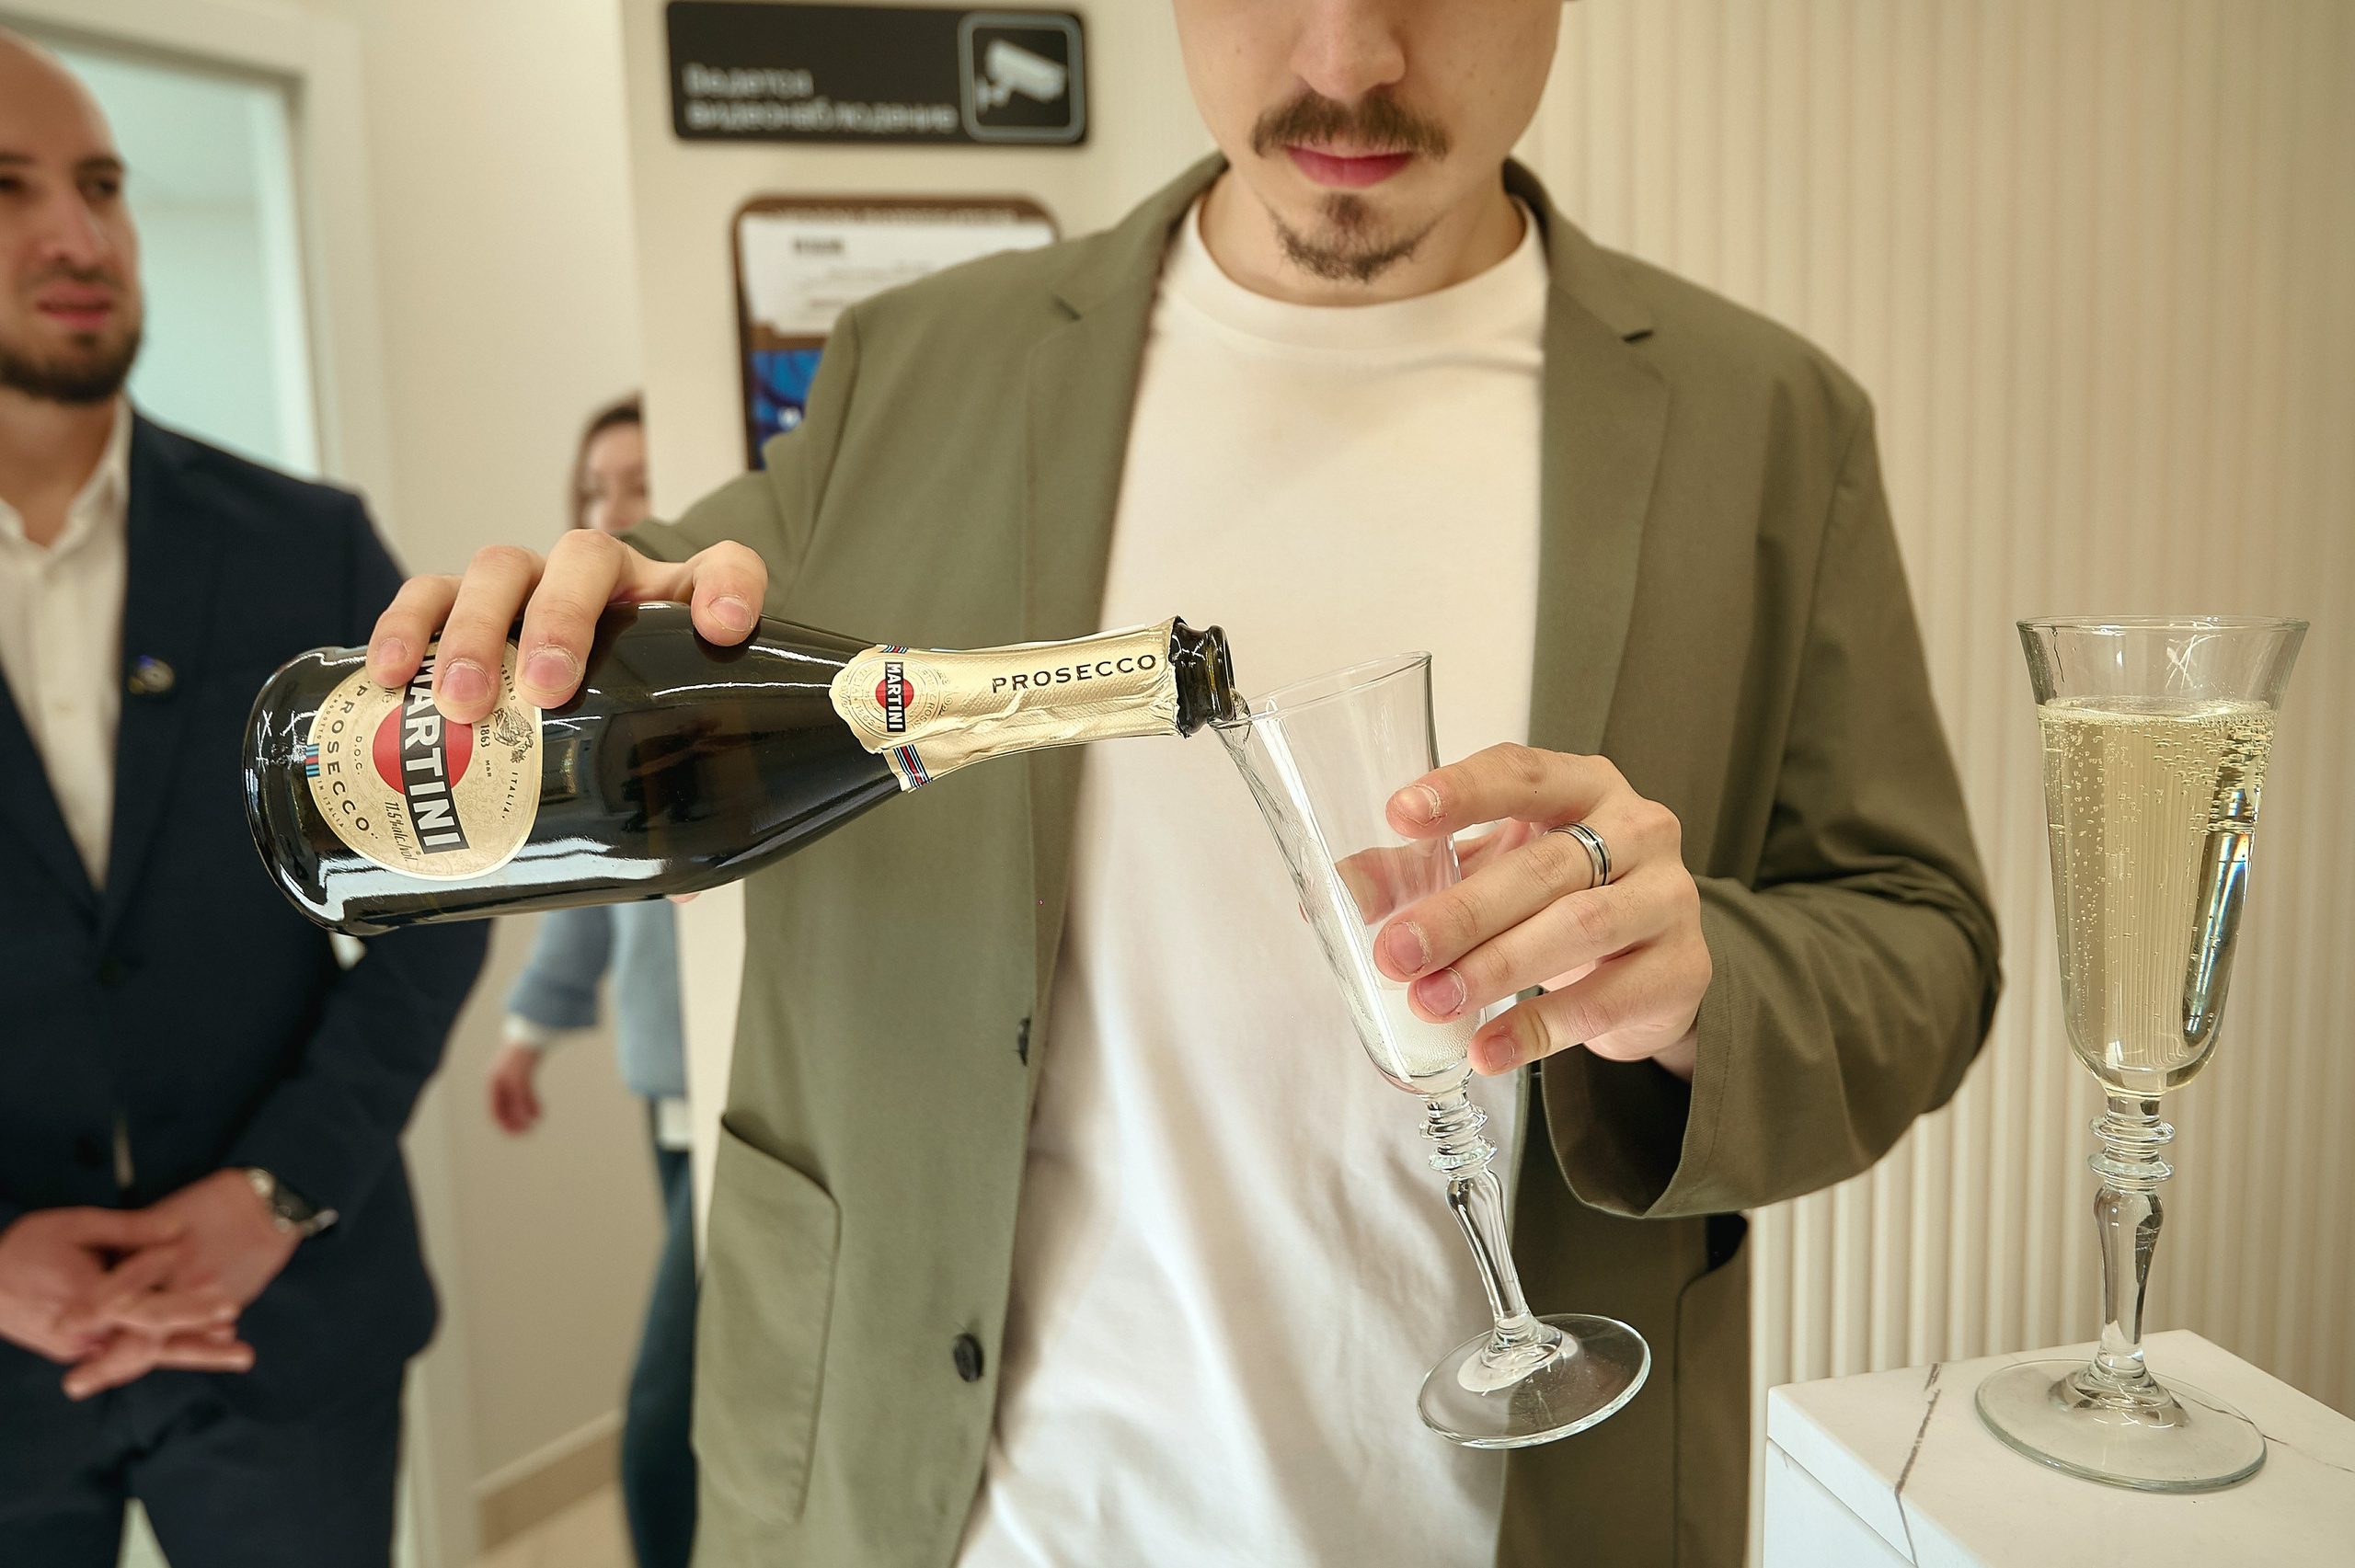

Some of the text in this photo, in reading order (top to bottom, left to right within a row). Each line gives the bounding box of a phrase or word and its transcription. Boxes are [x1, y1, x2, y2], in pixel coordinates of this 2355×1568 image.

[992, 654, 1156, 693] PROSECCO
[887, 662, 904, 729] MARTINI
[316, 693, 342, 739] PRODOTTO
[353, 736, 363, 775] D.O.C.
[479, 724, 491, 748] 1863
[327, 685, 370, 831] PROSECCO
[322, 796, 345, 829] ITALIA
